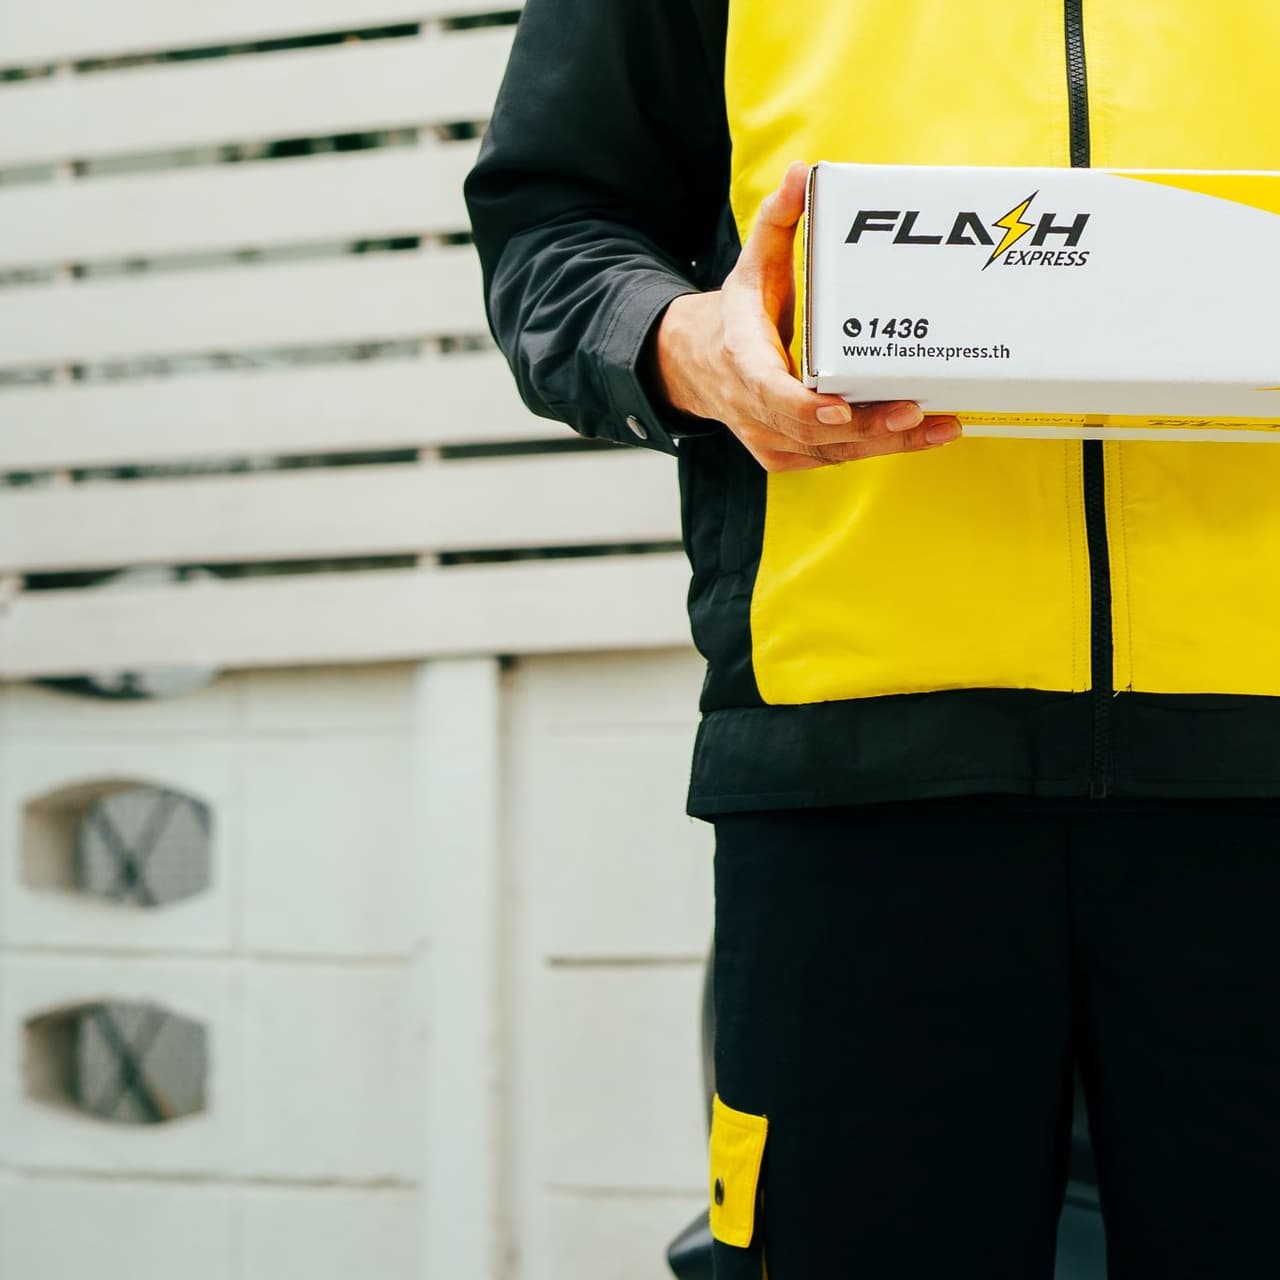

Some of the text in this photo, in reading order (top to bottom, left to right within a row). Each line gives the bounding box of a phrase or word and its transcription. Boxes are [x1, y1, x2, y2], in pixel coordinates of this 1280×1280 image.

[1003, 250, 1090, 267] EXPRESS
[868, 317, 930, 339] 1436
[843, 343, 1011, 361] www.flashexpress.th
